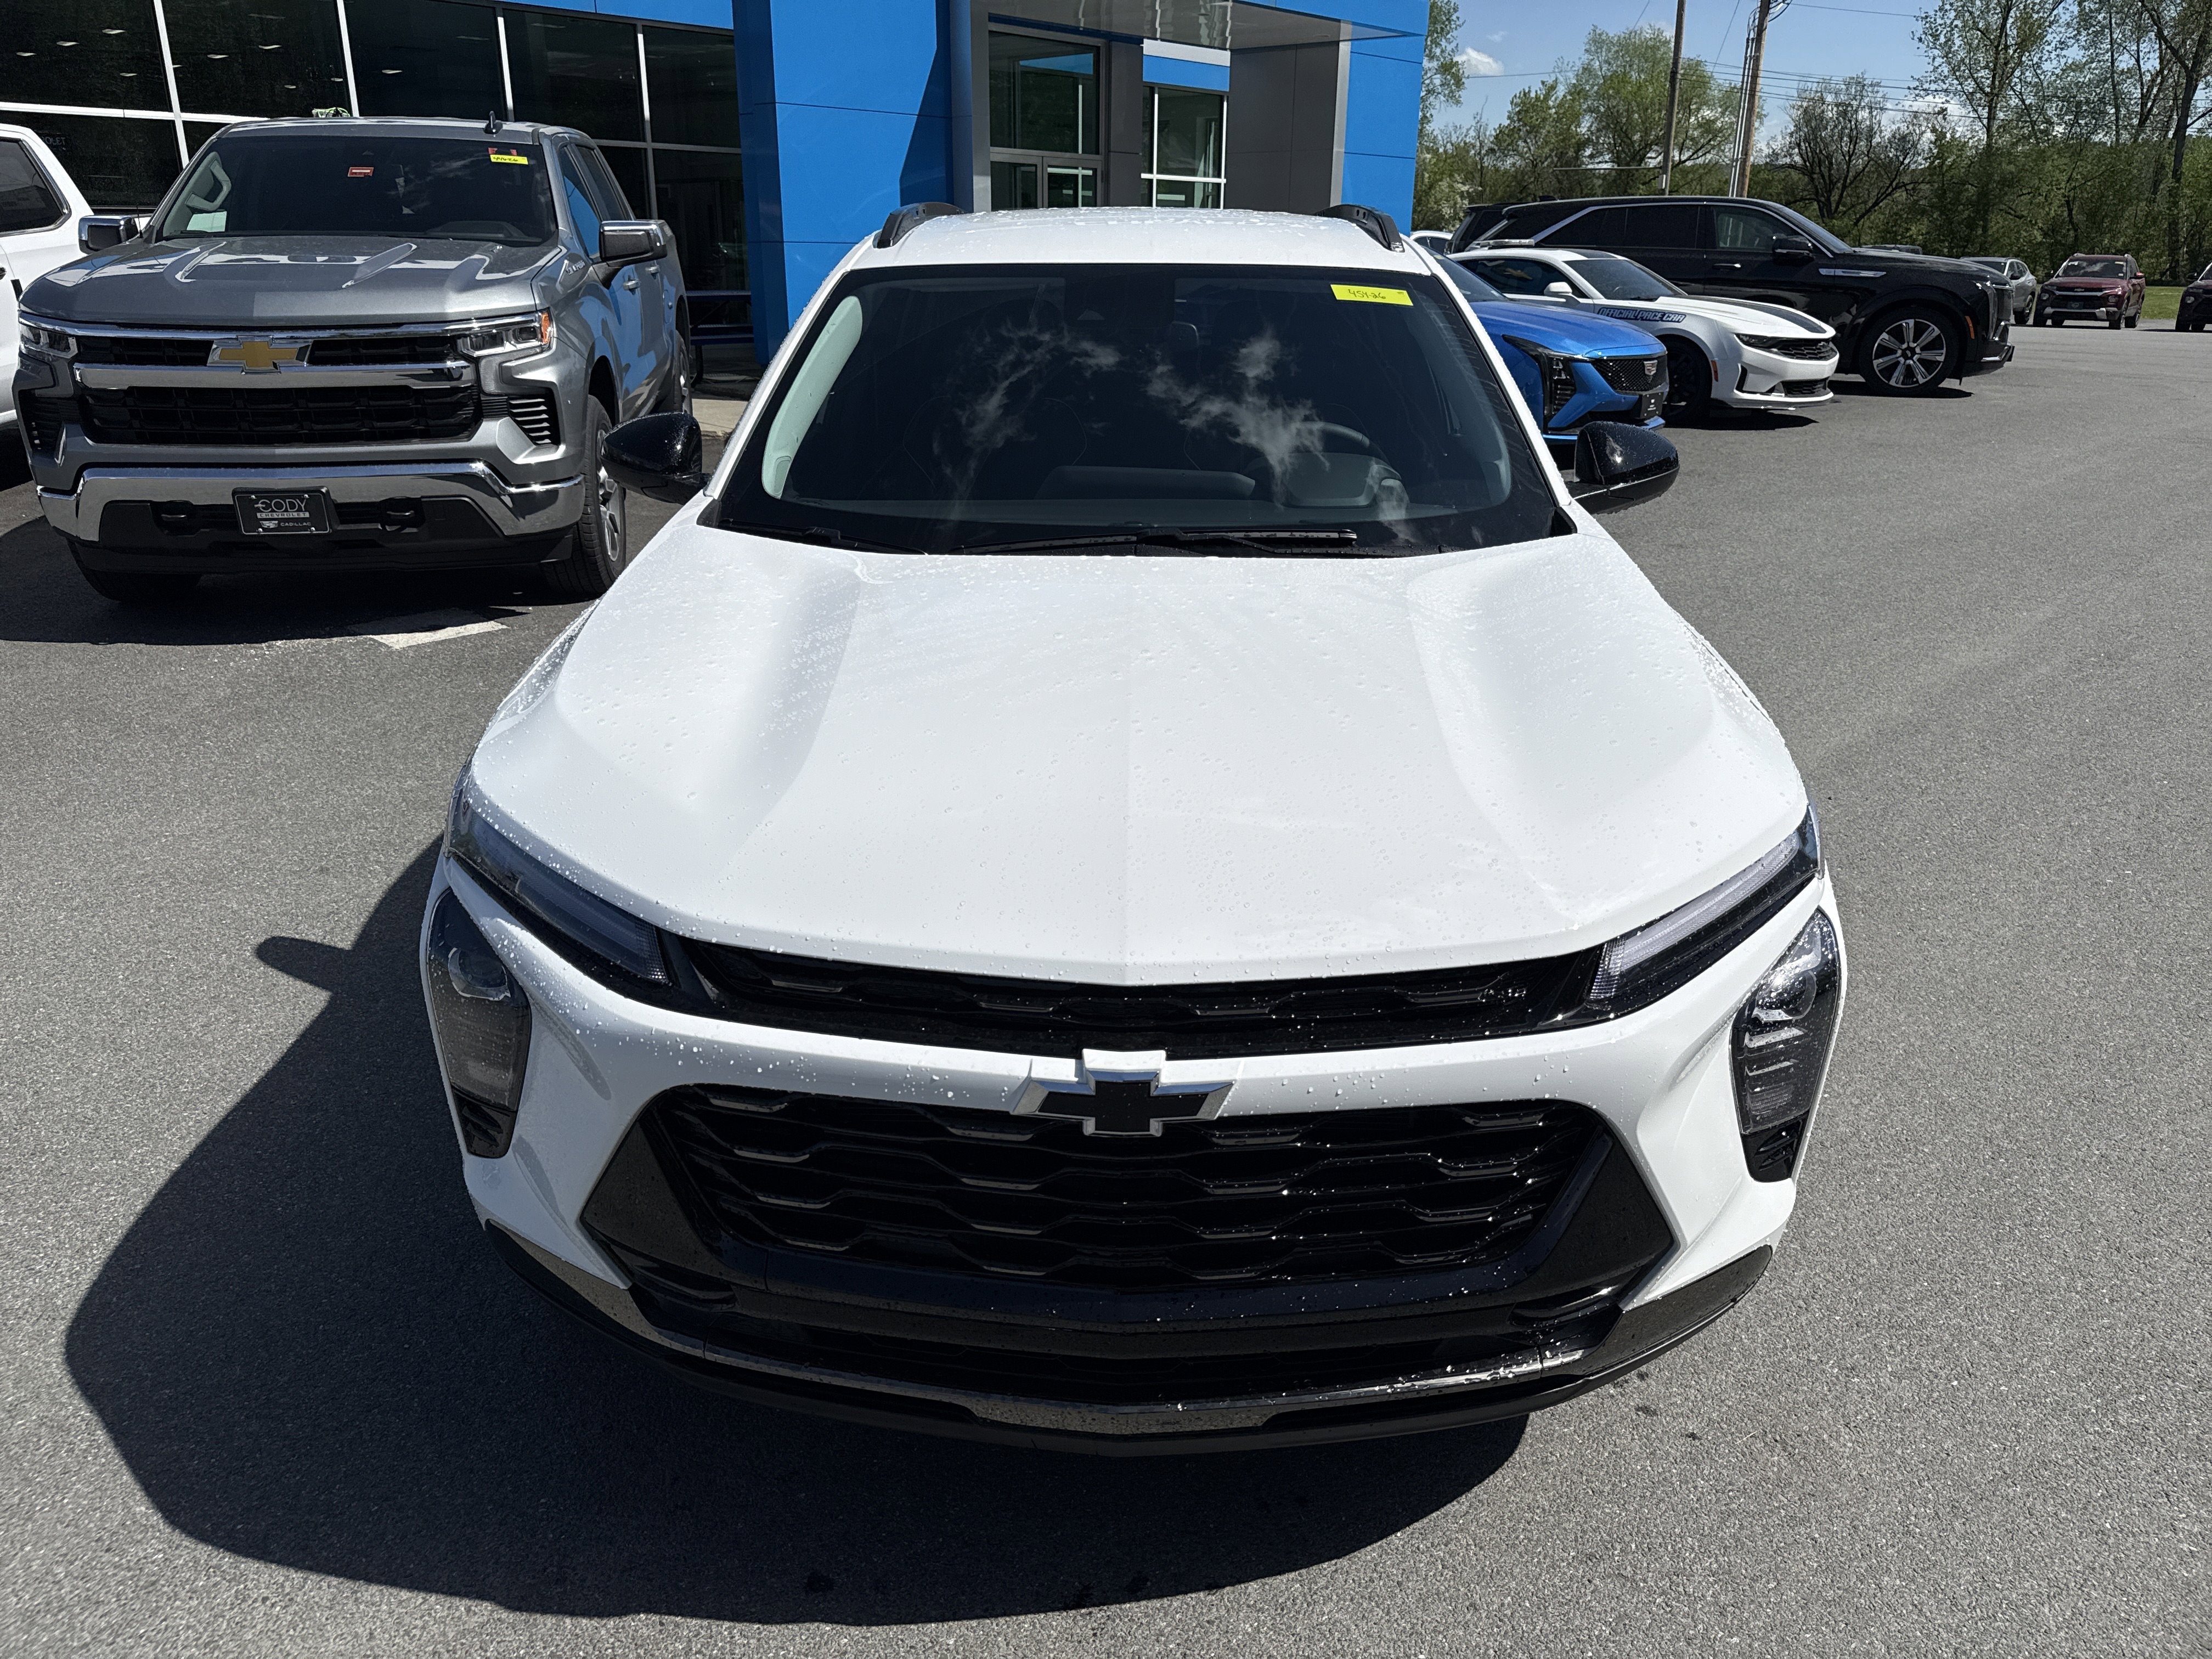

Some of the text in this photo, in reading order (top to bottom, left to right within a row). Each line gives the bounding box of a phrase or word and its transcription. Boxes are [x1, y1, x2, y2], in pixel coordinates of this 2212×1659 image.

[1347, 289, 1386, 300] 454-26
[1599, 308, 1685, 322] OFFICIAL PACE CAR
[258, 499, 307, 512] CODY
